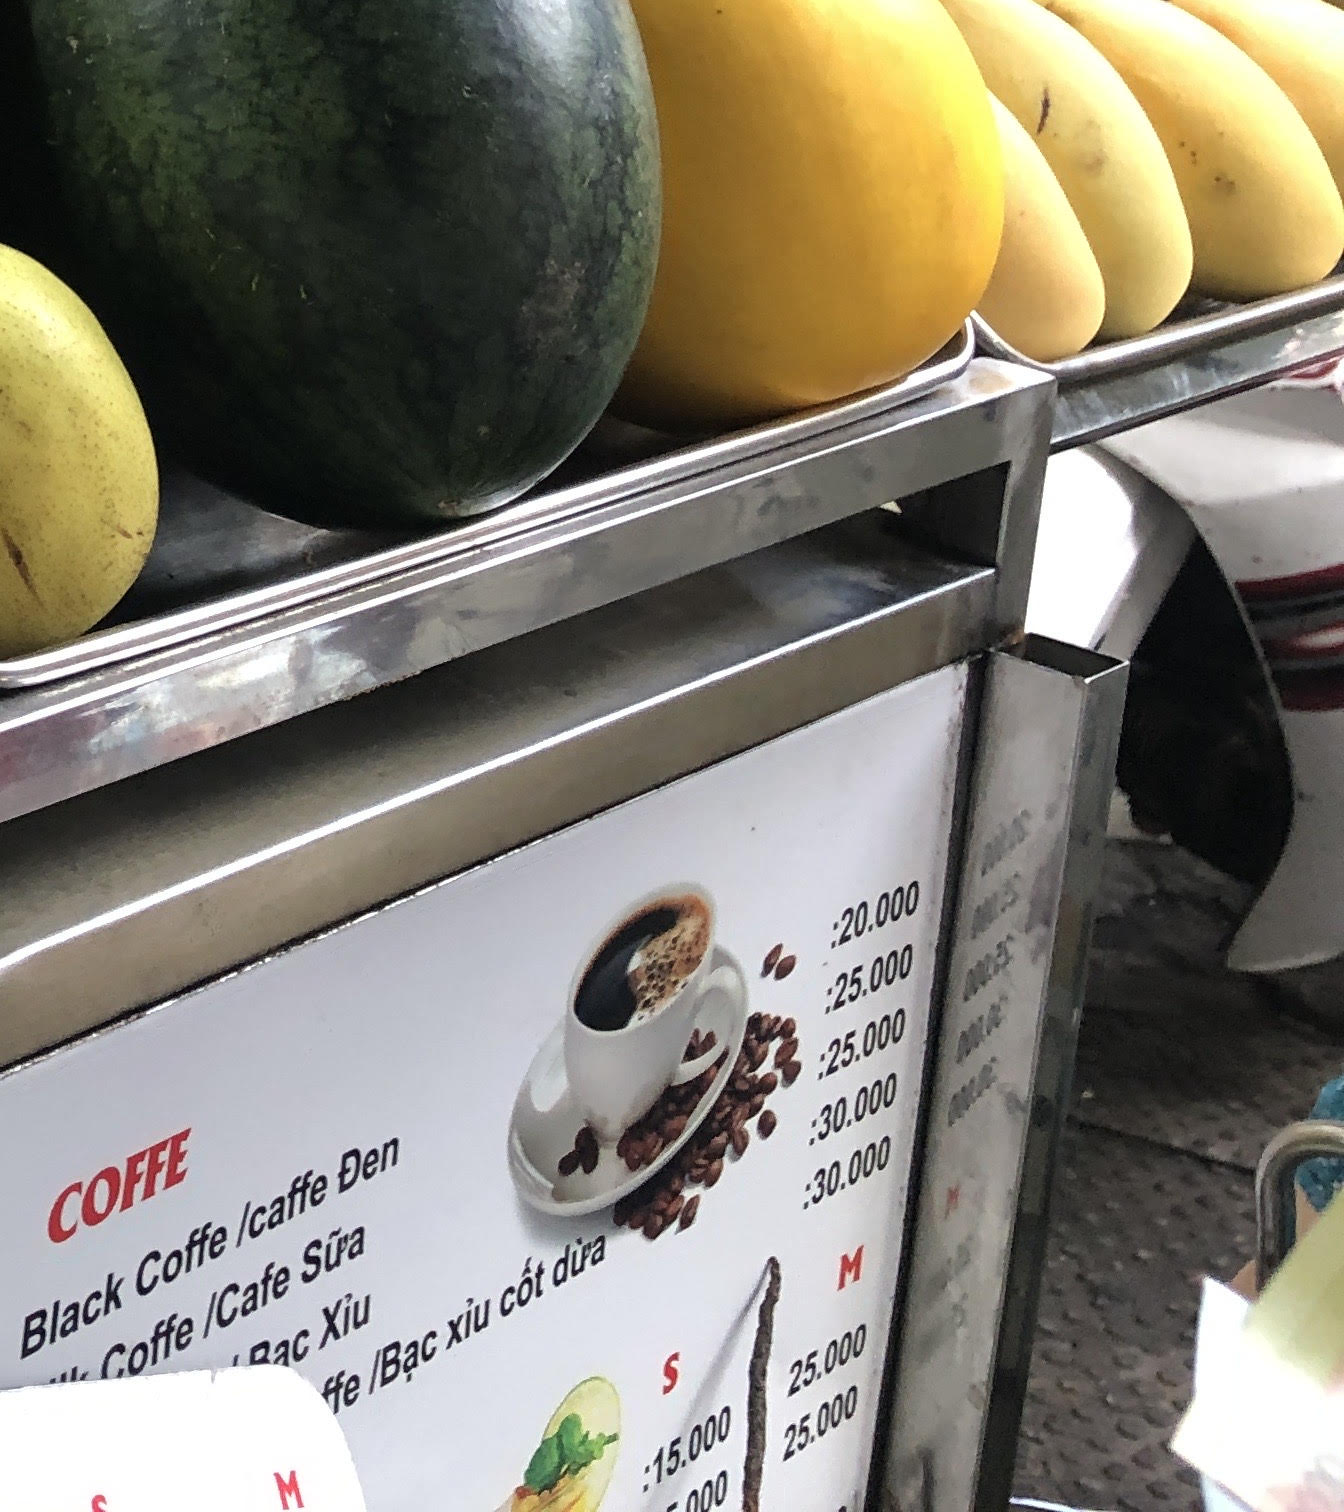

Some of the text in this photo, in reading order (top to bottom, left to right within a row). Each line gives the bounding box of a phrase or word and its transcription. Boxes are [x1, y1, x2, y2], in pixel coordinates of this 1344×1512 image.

[830, 880, 920, 949] :20.000
[824, 943, 913, 1015] :25.000
[817, 1007, 906, 1080] :25.000
[808, 1072, 897, 1146] :30.000
[47, 1127, 192, 1244] COFFE
[802, 1135, 892, 1210] :30.000
[19, 1272, 125, 1360] Black
[135, 1221, 228, 1297] Coffe
[337, 1136, 400, 1194] Đen
[836, 1244, 865, 1291] M
[100, 1312, 194, 1379] Coffe
[300, 1225, 366, 1284] Sữa
[445, 1297, 491, 1351] xỉu
[499, 1255, 545, 1317] cốt
[552, 1233, 607, 1288] dừa
[662, 1351, 681, 1395] S
[787, 1323, 867, 1397] 25.000
[782, 1384, 858, 1463] 25.000
[272, 1470, 305, 1510] M
